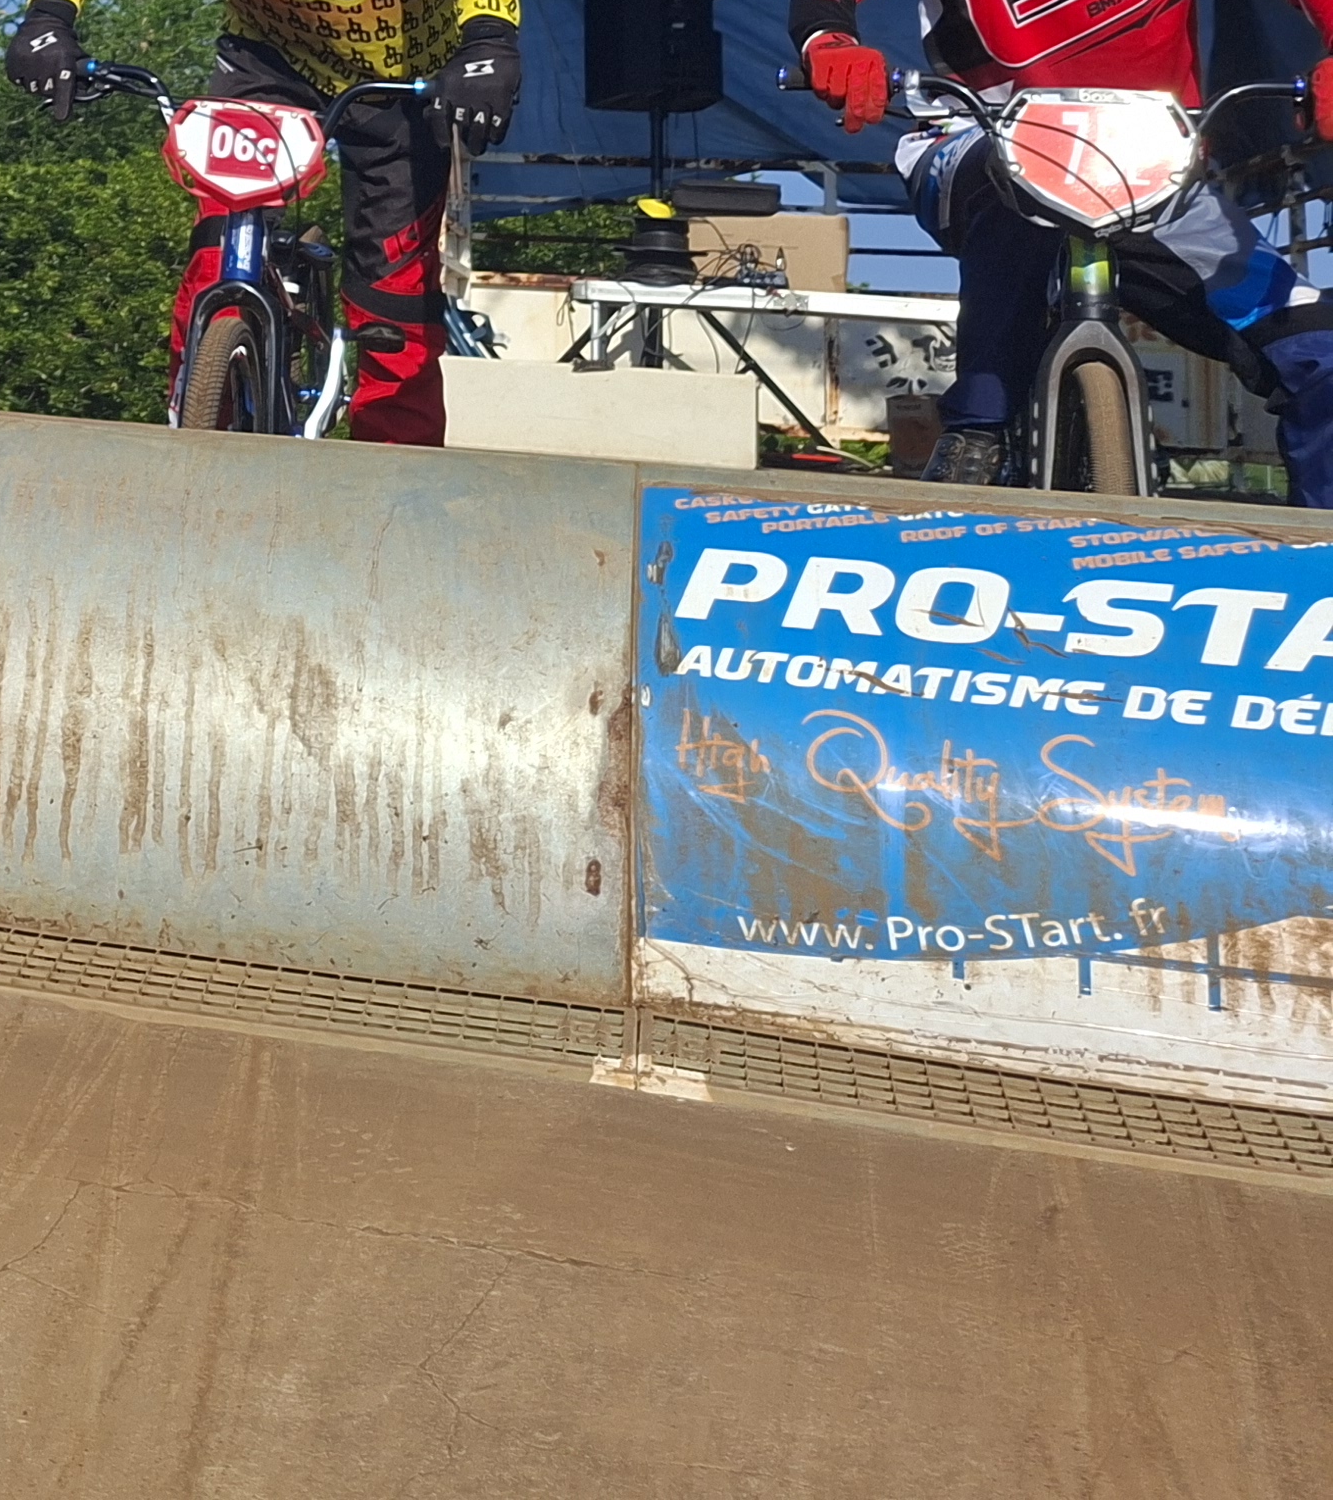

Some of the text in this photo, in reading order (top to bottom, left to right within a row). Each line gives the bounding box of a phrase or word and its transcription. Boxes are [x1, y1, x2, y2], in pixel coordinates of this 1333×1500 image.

[705, 504, 801, 525] SAFETY
[761, 512, 890, 535] PORTABLE
[900, 526, 967, 544] ROOF
[974, 522, 1008, 537] OF
[1071, 538, 1280, 571] MOBILE SAFETY
[676, 645, 1107, 716] AUTOMATISME
[1122, 685, 1212, 726] DE
